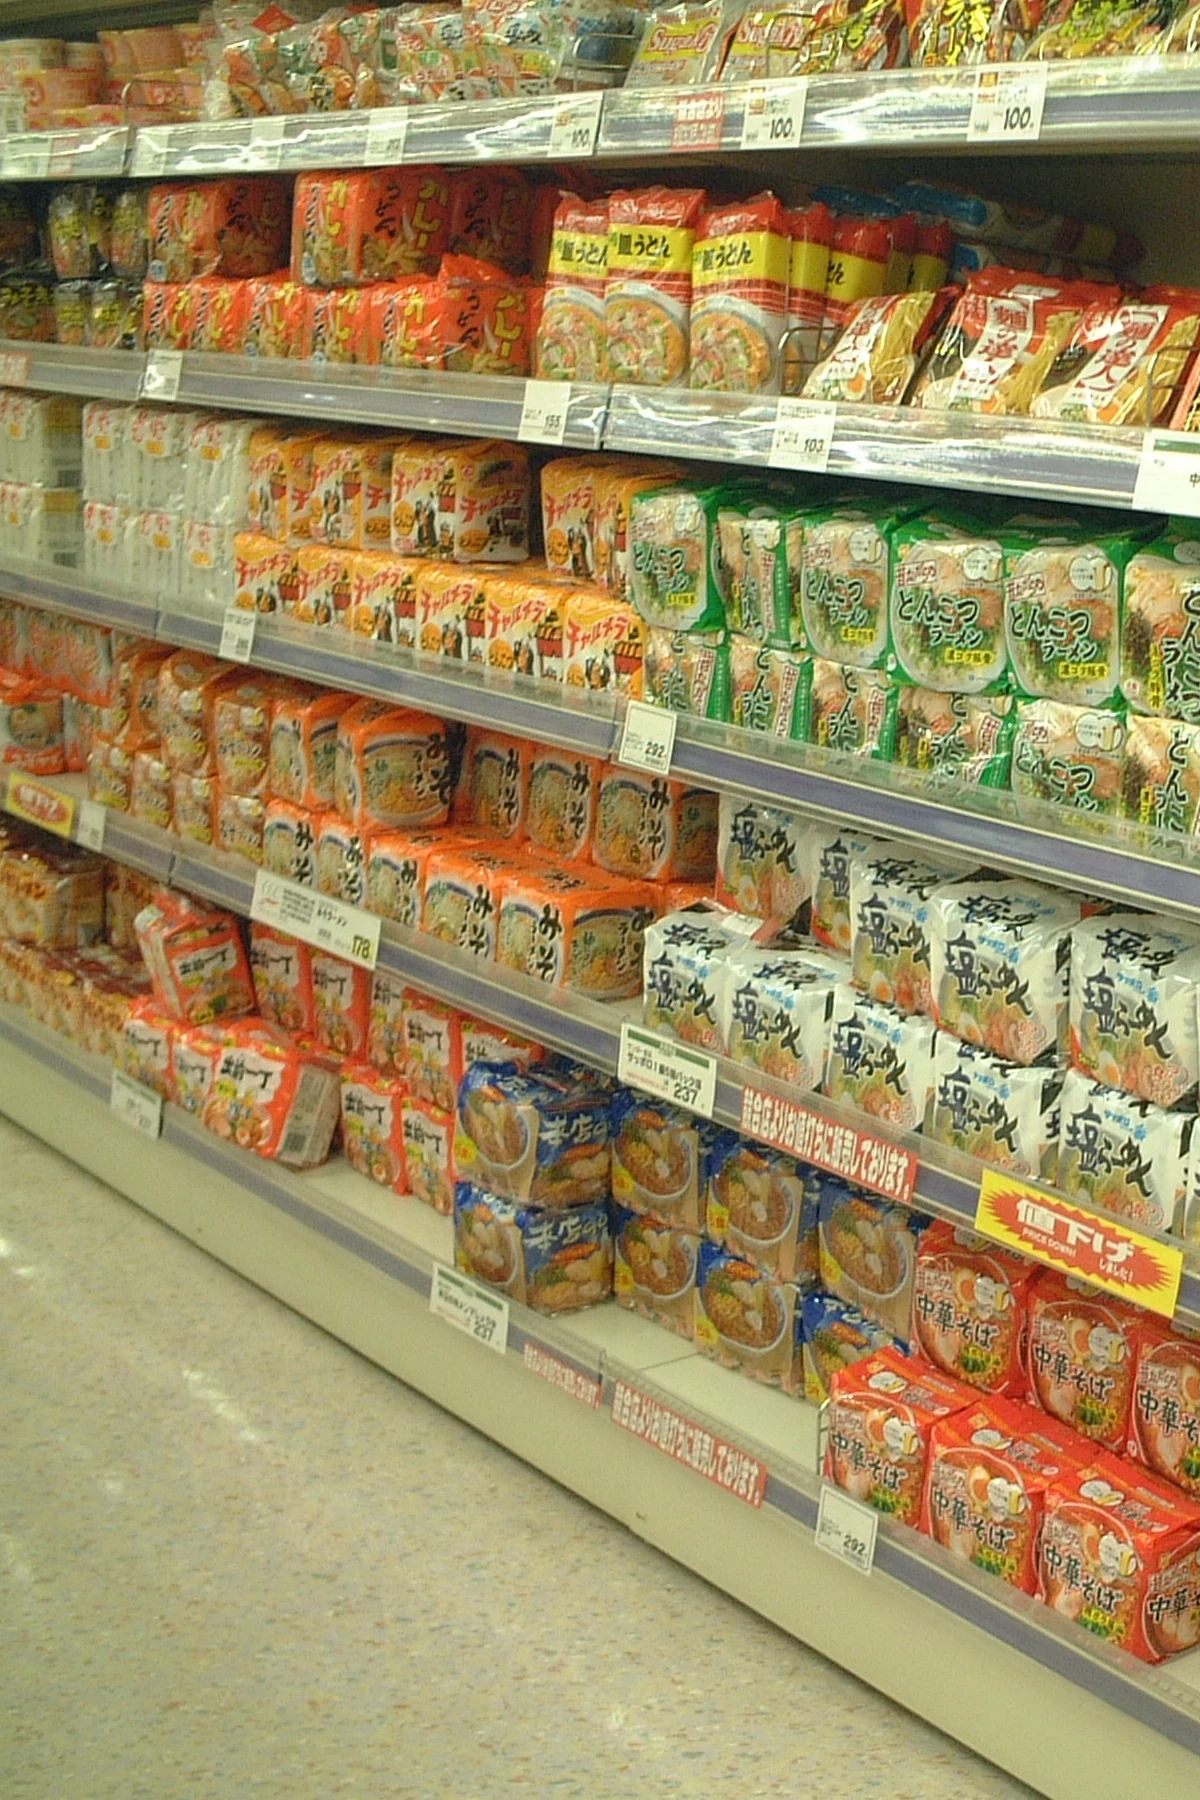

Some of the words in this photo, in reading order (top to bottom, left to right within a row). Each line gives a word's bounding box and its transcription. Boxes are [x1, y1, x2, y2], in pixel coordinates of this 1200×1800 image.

[769, 118, 793, 140] 100
[1003, 106, 1032, 131] 100
[616, 232, 672, 259] 皿うどん
[803, 439, 824, 452] 103
[805, 569, 865, 605] とんこつ
[897, 590, 981, 625] とんこつ
[929, 626, 983, 649] ラーメン
[1008, 605, 1092, 640] とんこつ
[1042, 640, 1099, 663] ラーメン
[945, 929, 1032, 1017] 塩らーめん
[1082, 966, 1172, 1060] 塩らーめん
[832, 1011, 908, 1096] 塩らーめん
[673, 1083, 699, 1106] 237
[938, 1064, 1019, 1153] 塩らーめん
[1066, 1103, 1153, 1198] 塩らーめん
[1016, 1198, 1135, 1263] 値下げ
[916, 1294, 1001, 1350] 中華そば
[1034, 1343, 1116, 1402] 中華そば
[831, 1431, 908, 1491] 中華そば
[933, 1489, 1015, 1553] 中華そば
[1044, 1546, 1124, 1613] 中華そば
